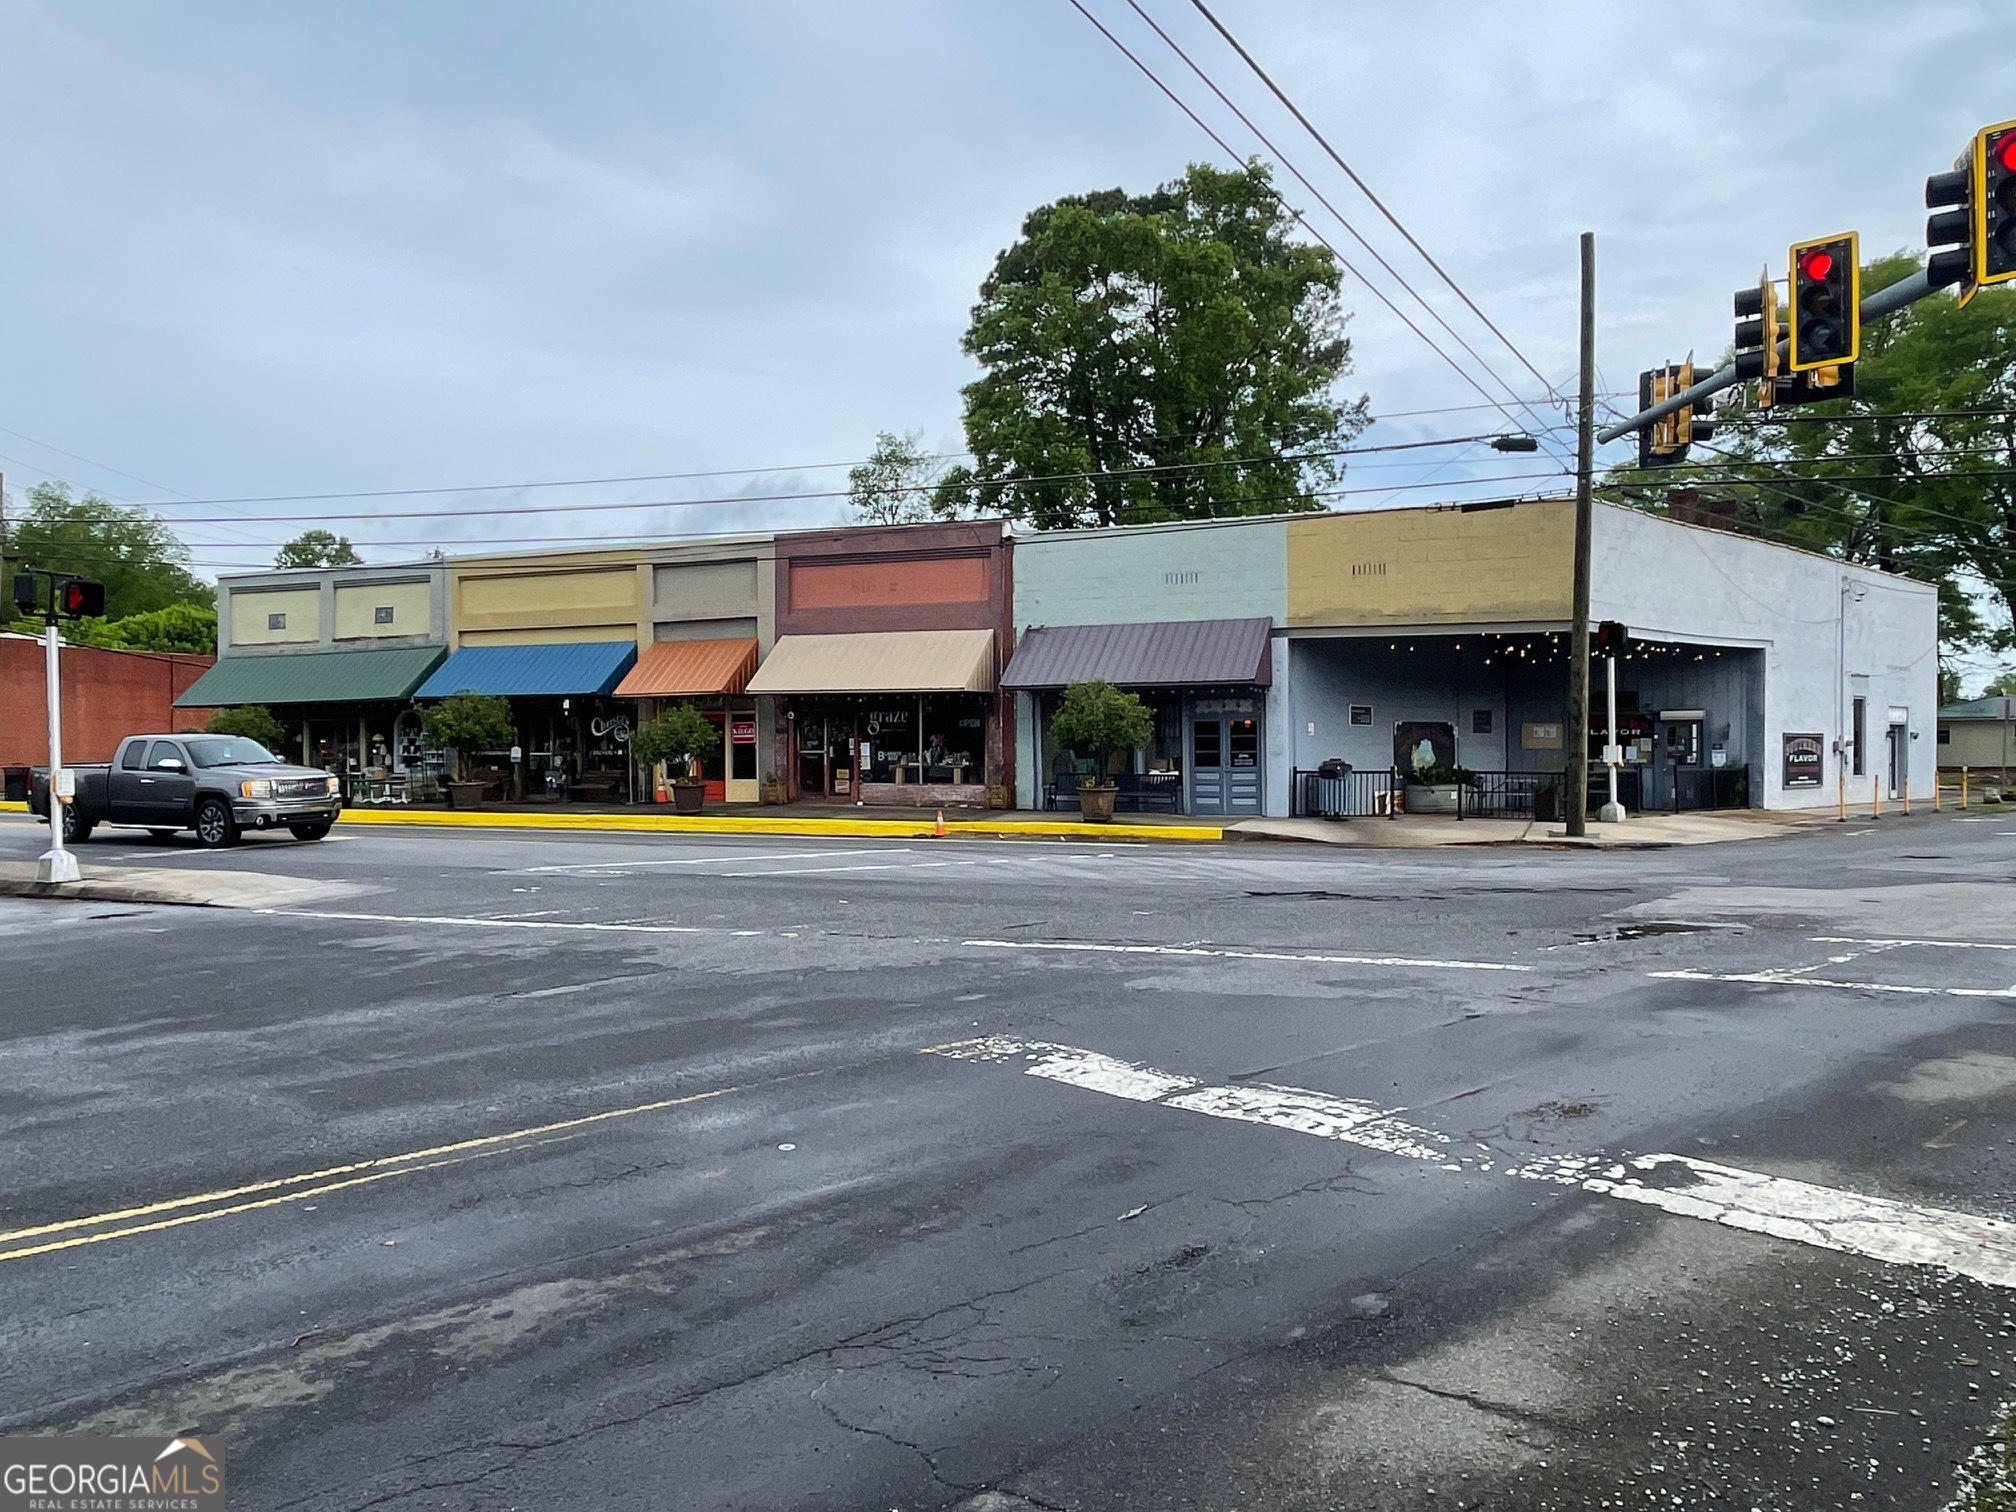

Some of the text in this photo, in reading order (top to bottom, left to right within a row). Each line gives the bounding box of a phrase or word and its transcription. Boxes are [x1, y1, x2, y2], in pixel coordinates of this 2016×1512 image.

[867, 710, 909, 735] graze
[958, 718, 981, 727] OPEN
[1789, 754, 1818, 763] FLAVOR
